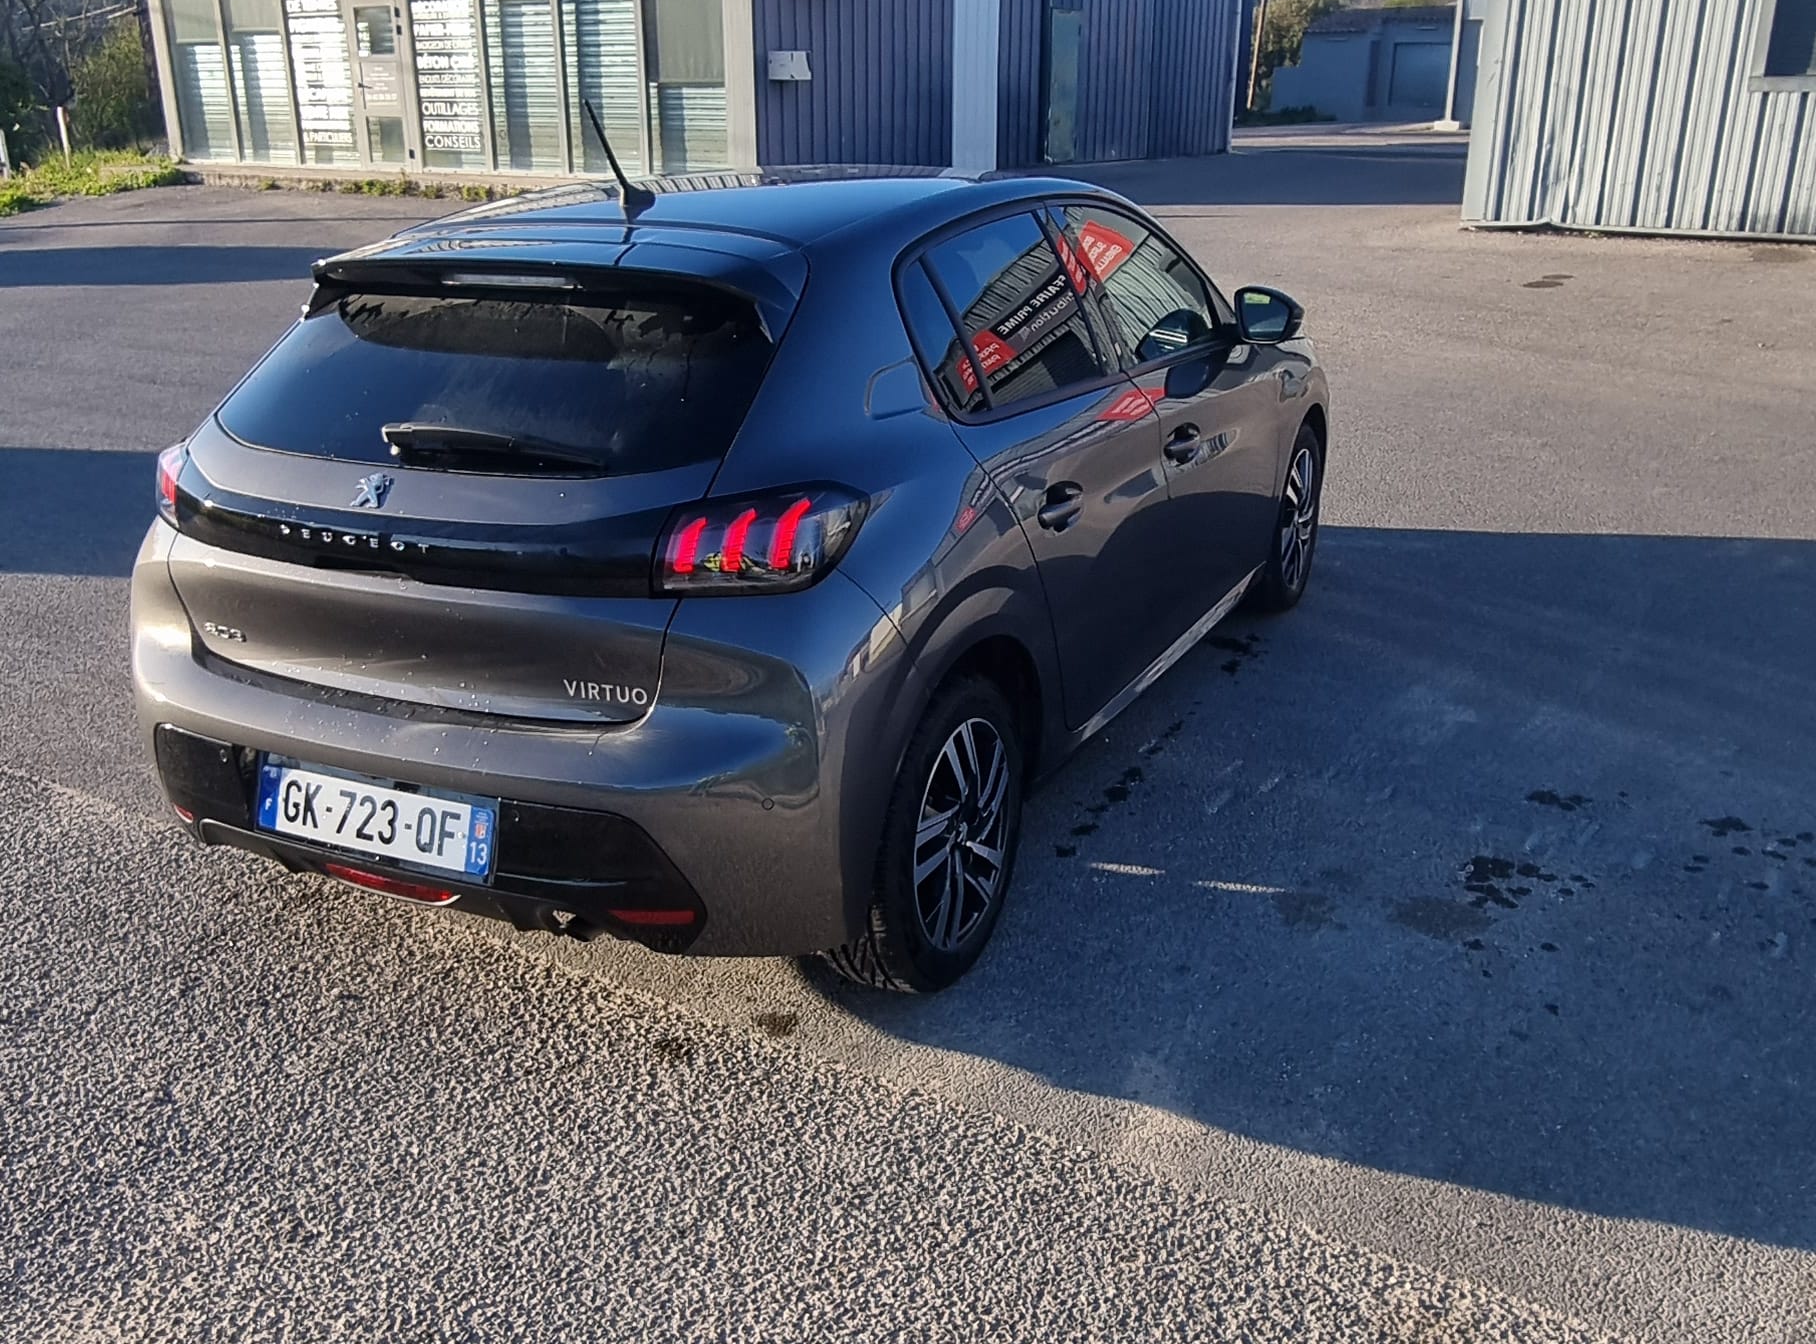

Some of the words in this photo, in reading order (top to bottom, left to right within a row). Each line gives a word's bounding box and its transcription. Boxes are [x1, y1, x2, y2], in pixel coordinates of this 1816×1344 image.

[425, 136, 481, 149] CONSEILS
[563, 679, 648, 705] VIRTUO
[264, 797, 273, 811] F
[470, 841, 487, 865] 13
